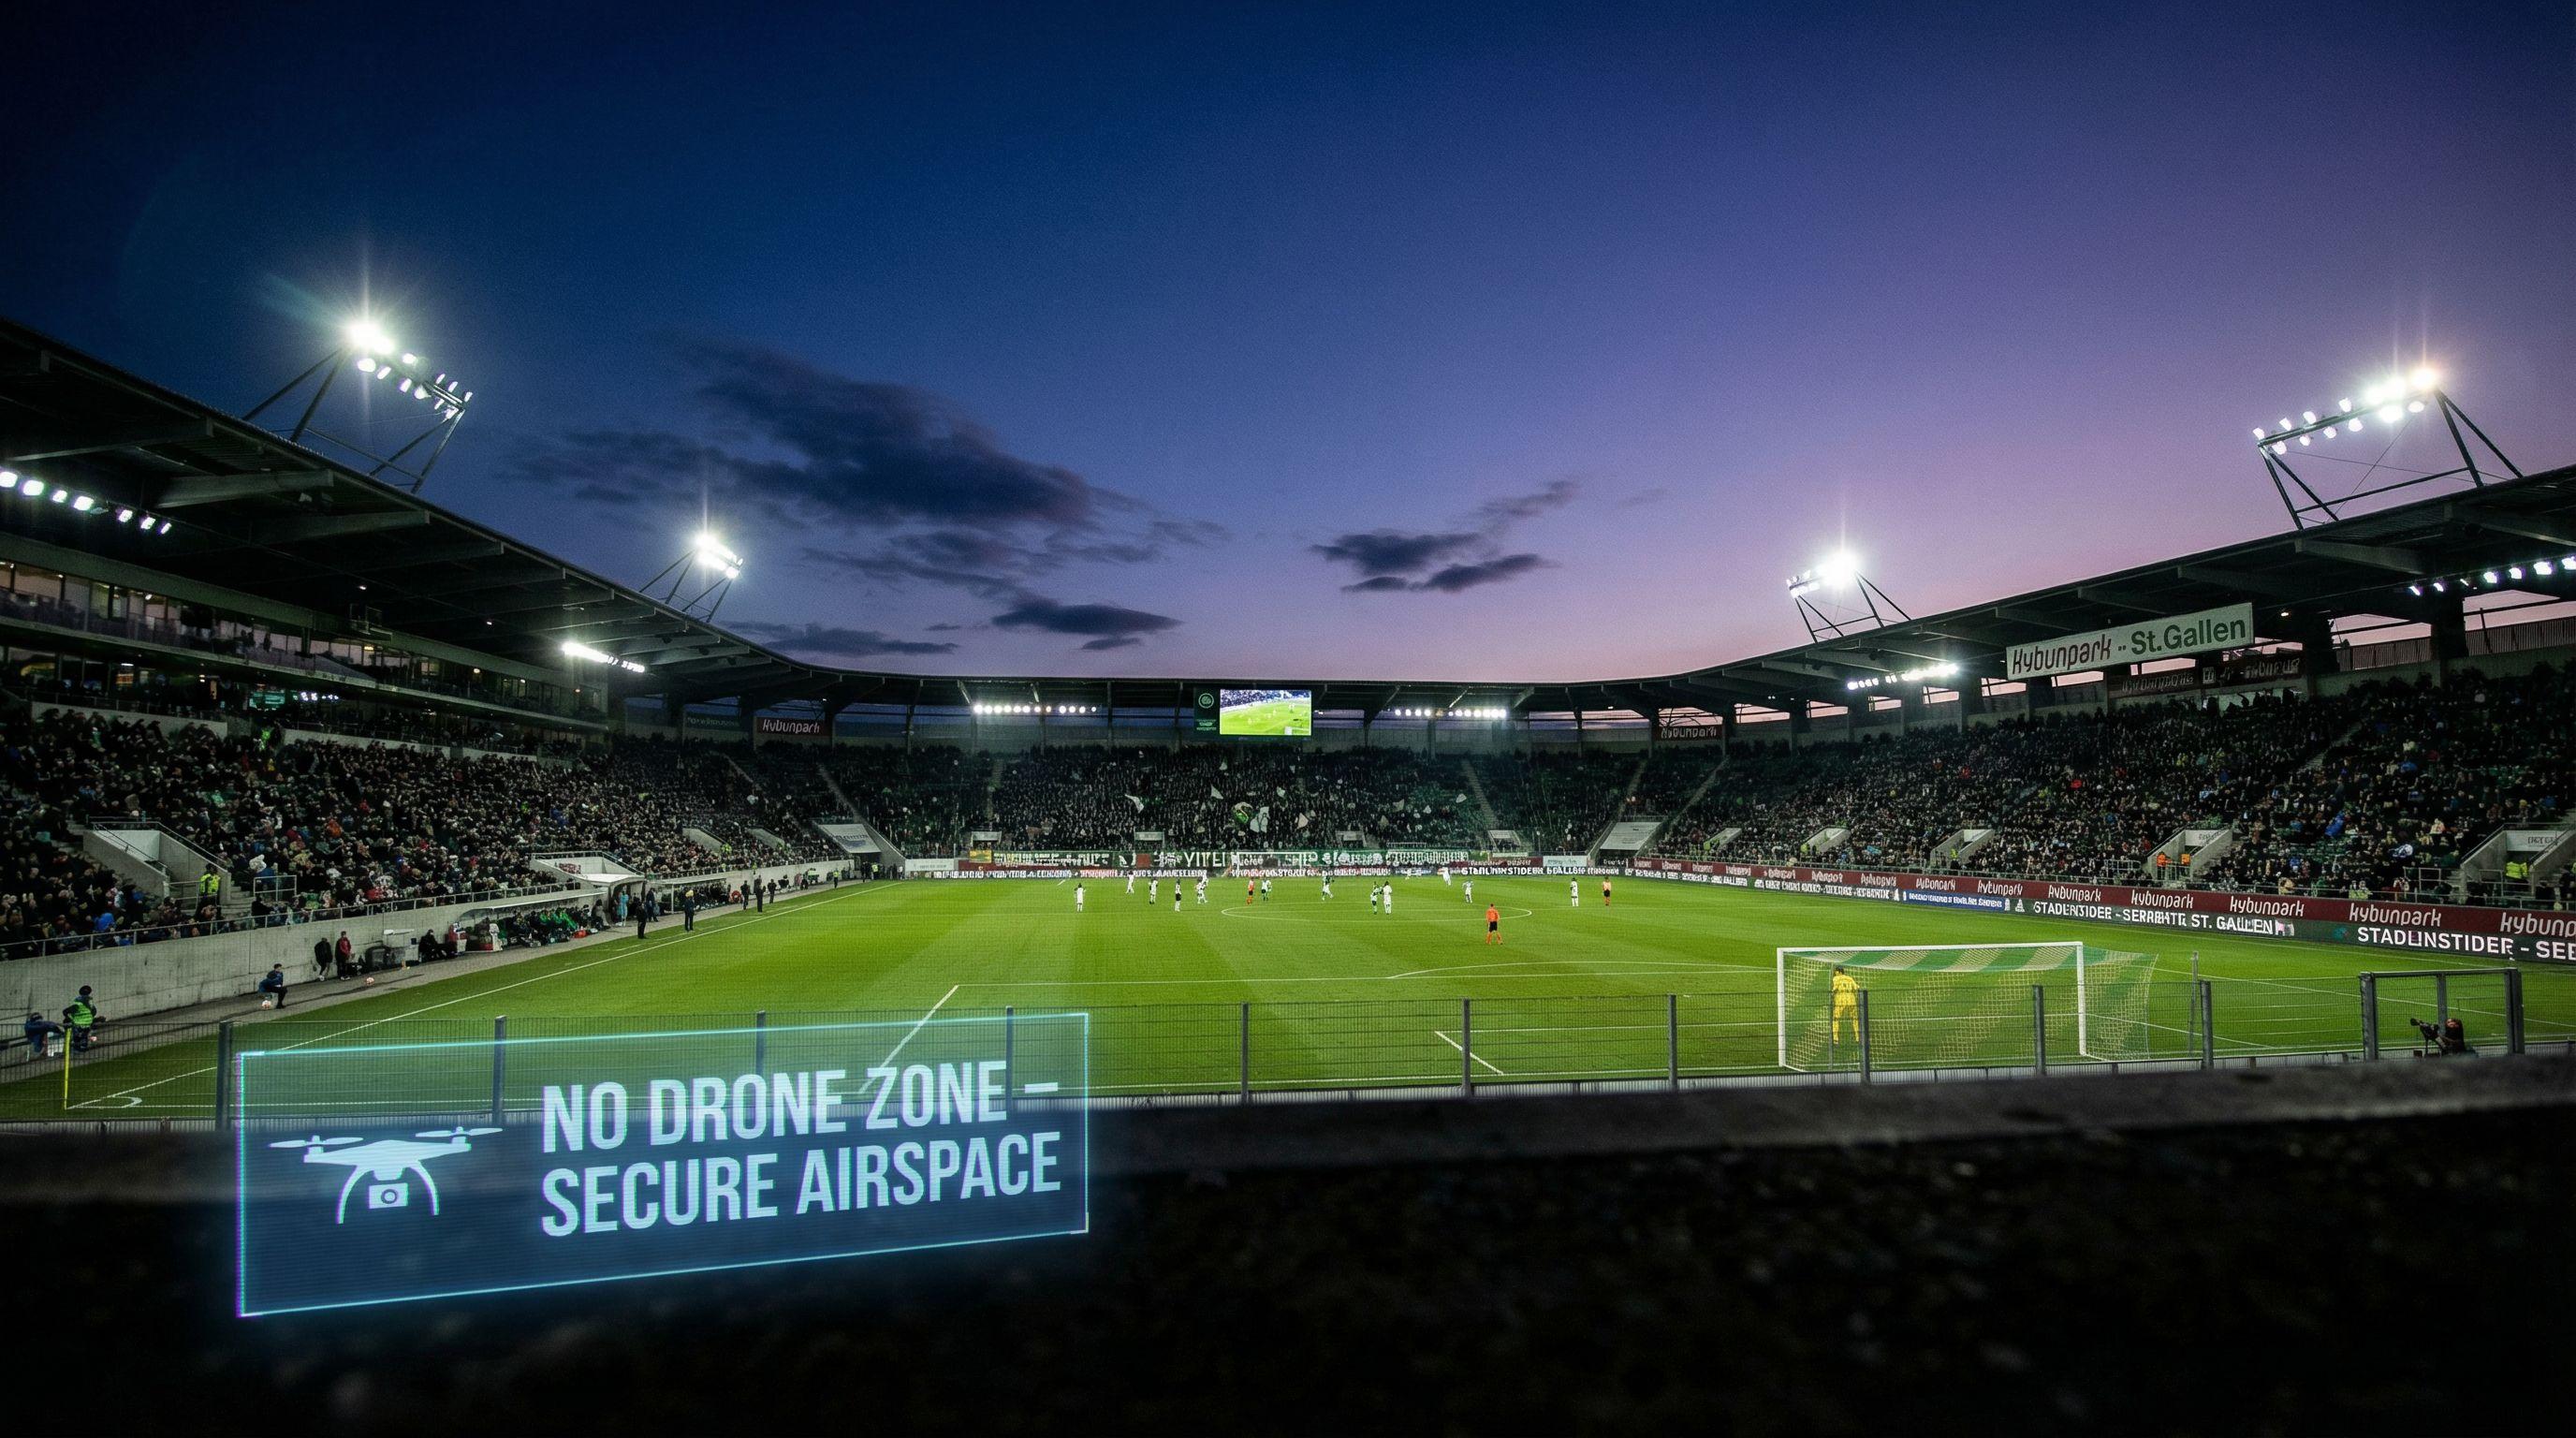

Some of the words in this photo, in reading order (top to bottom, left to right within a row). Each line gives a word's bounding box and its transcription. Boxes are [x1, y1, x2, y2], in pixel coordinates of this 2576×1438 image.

[2229, 896, 2305, 917] kybunpark
[2349, 902, 2442, 927] kybunpark
[2191, 914, 2213, 929] ST.
